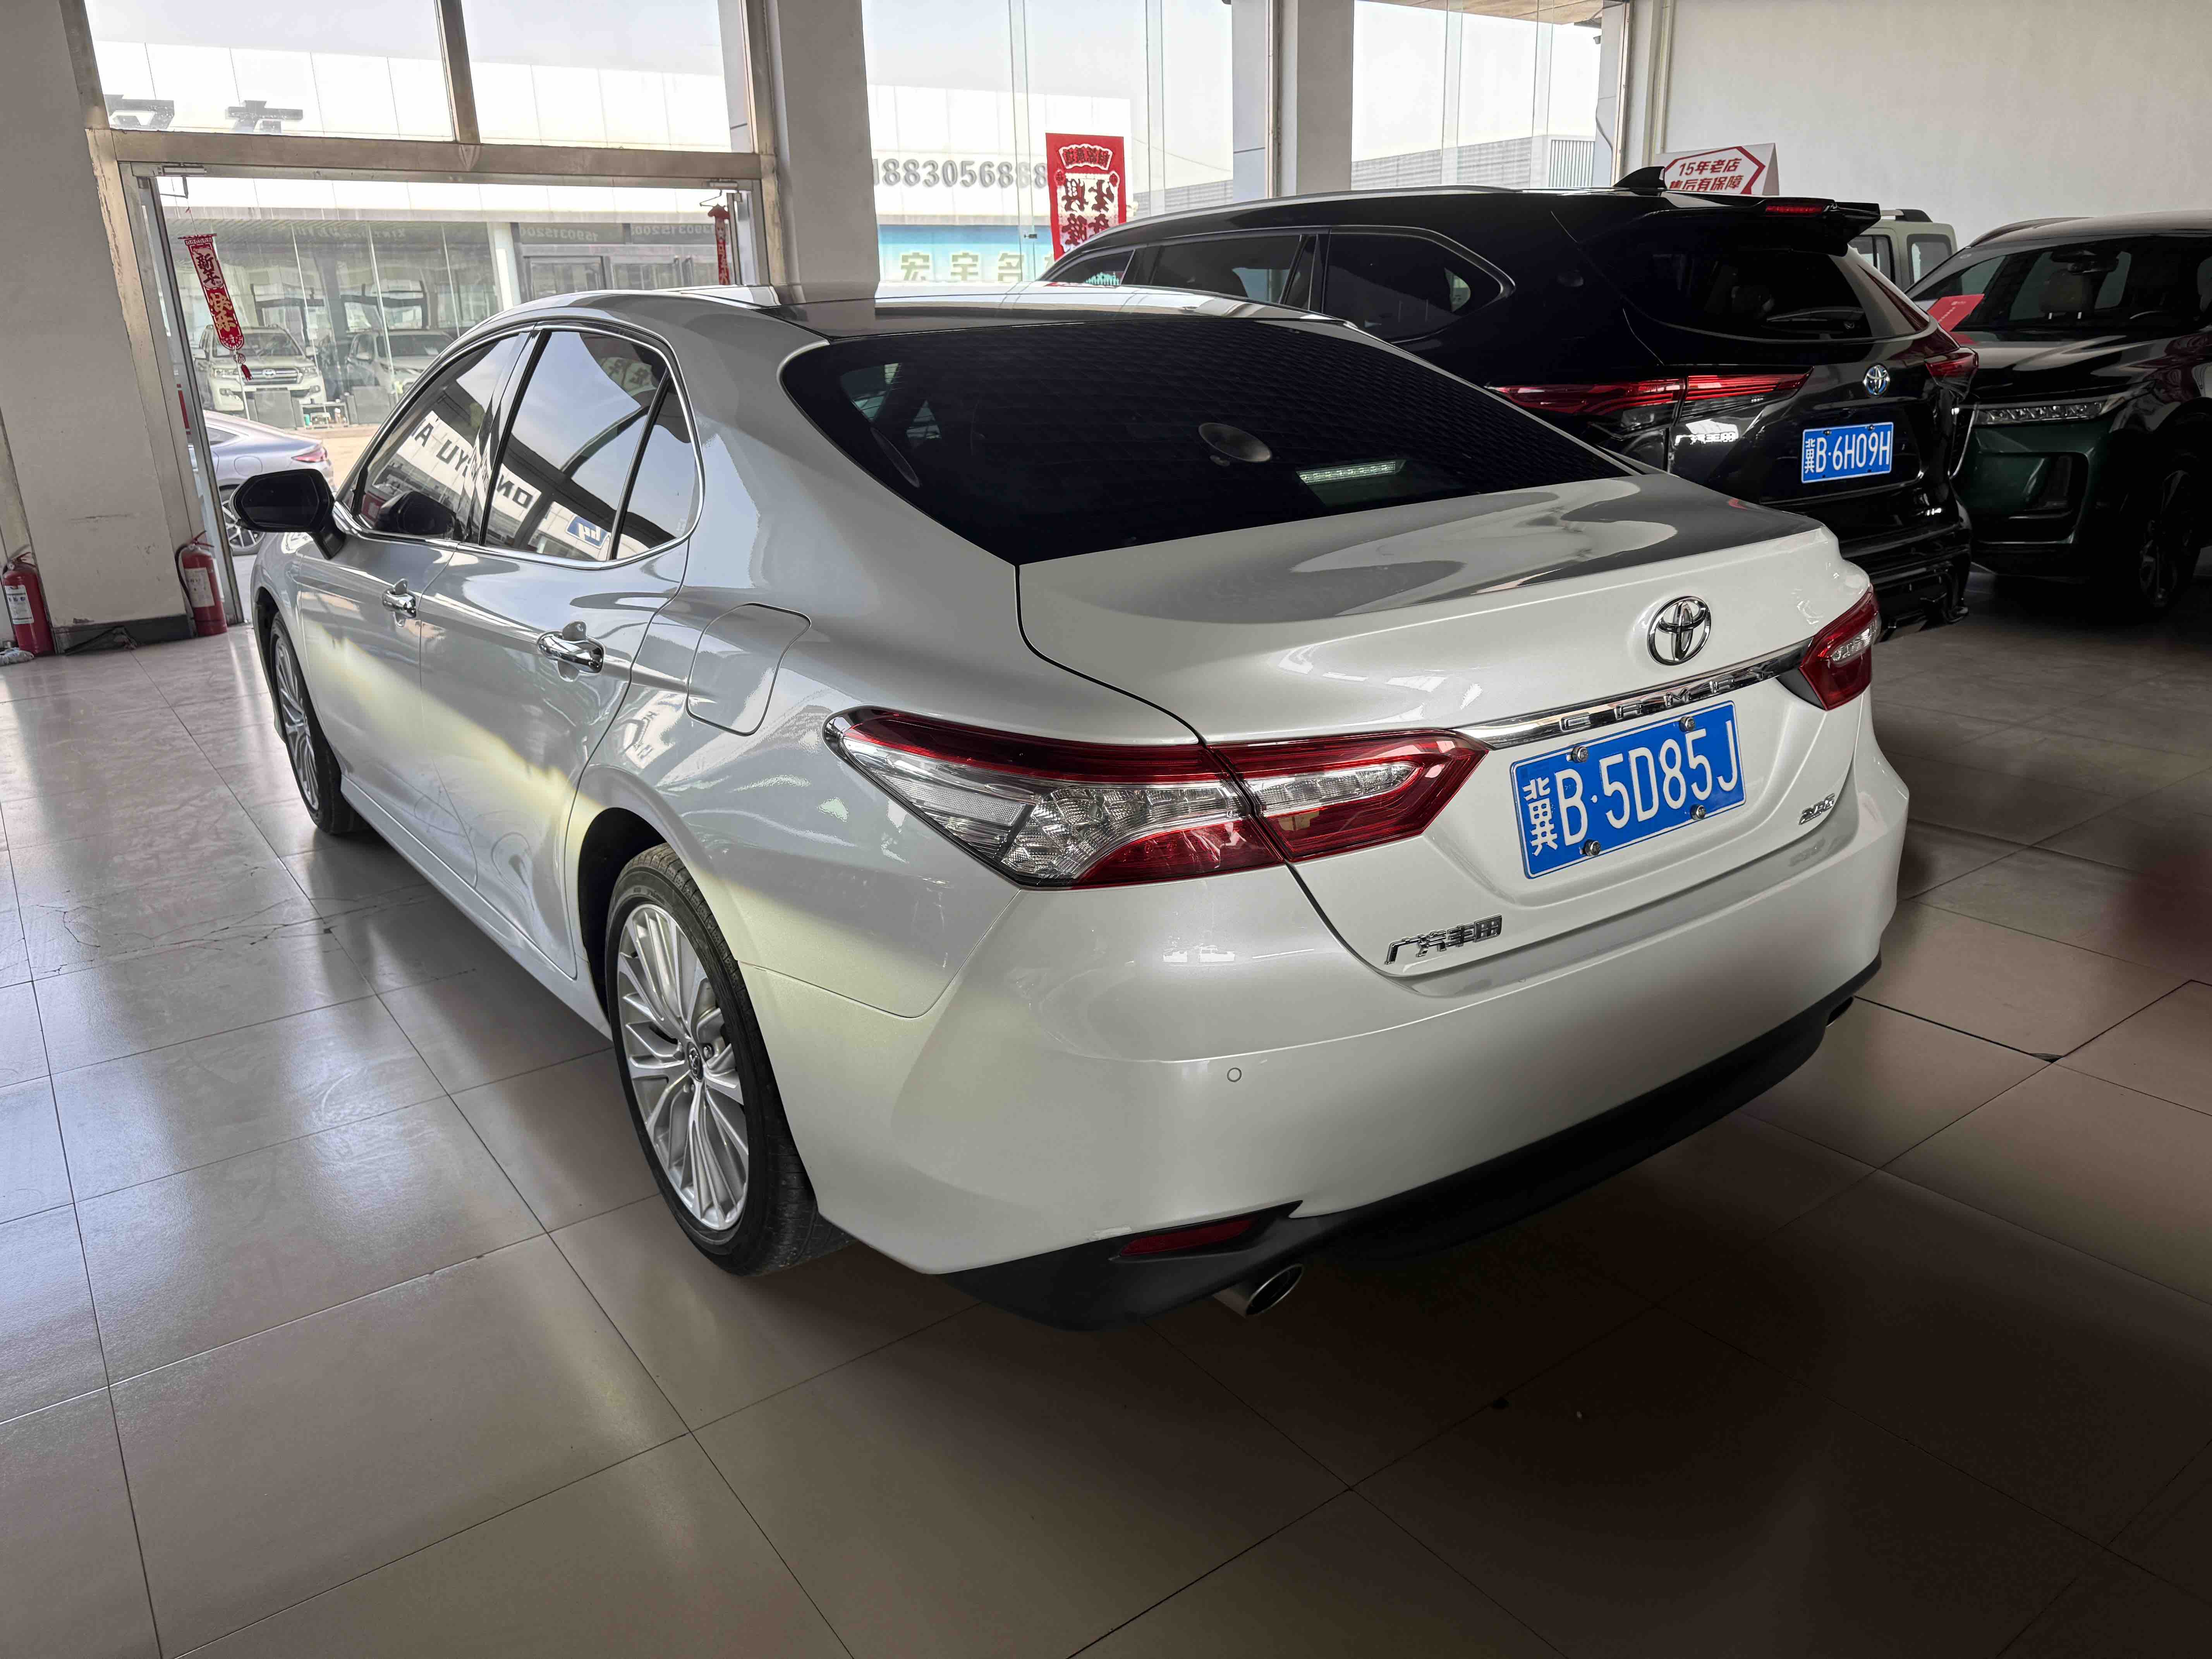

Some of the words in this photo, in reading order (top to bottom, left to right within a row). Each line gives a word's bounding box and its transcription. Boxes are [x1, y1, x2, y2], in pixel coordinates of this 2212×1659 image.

[1678, 158, 1743, 177] 15年老店
[1804, 431, 1891, 474] 冀B·6H09H
[1522, 720, 1738, 856] 冀B·5D85J
[1384, 914, 1503, 965] 广汽丰田
